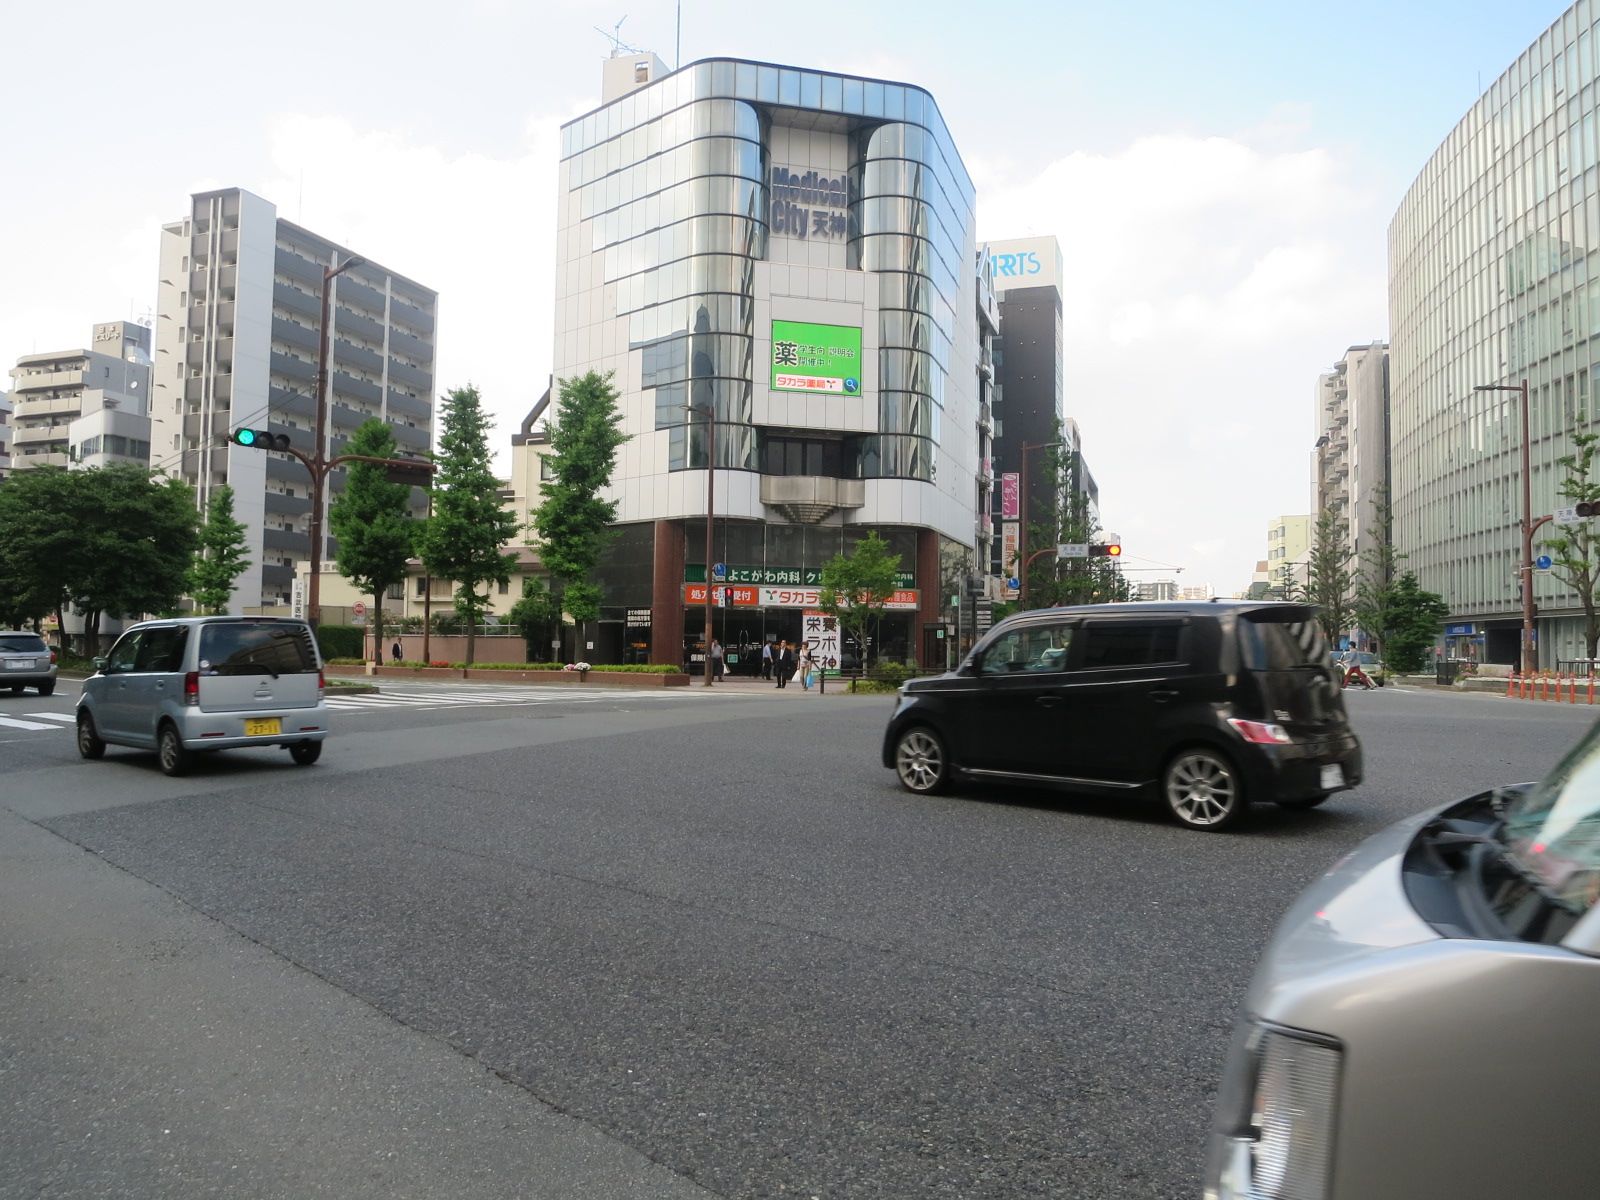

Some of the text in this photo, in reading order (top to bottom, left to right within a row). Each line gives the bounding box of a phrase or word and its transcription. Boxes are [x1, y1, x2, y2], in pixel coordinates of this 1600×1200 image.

[772, 166, 847, 206] Medical
[772, 200, 847, 239] City 天神
[774, 341, 798, 366] 薬
